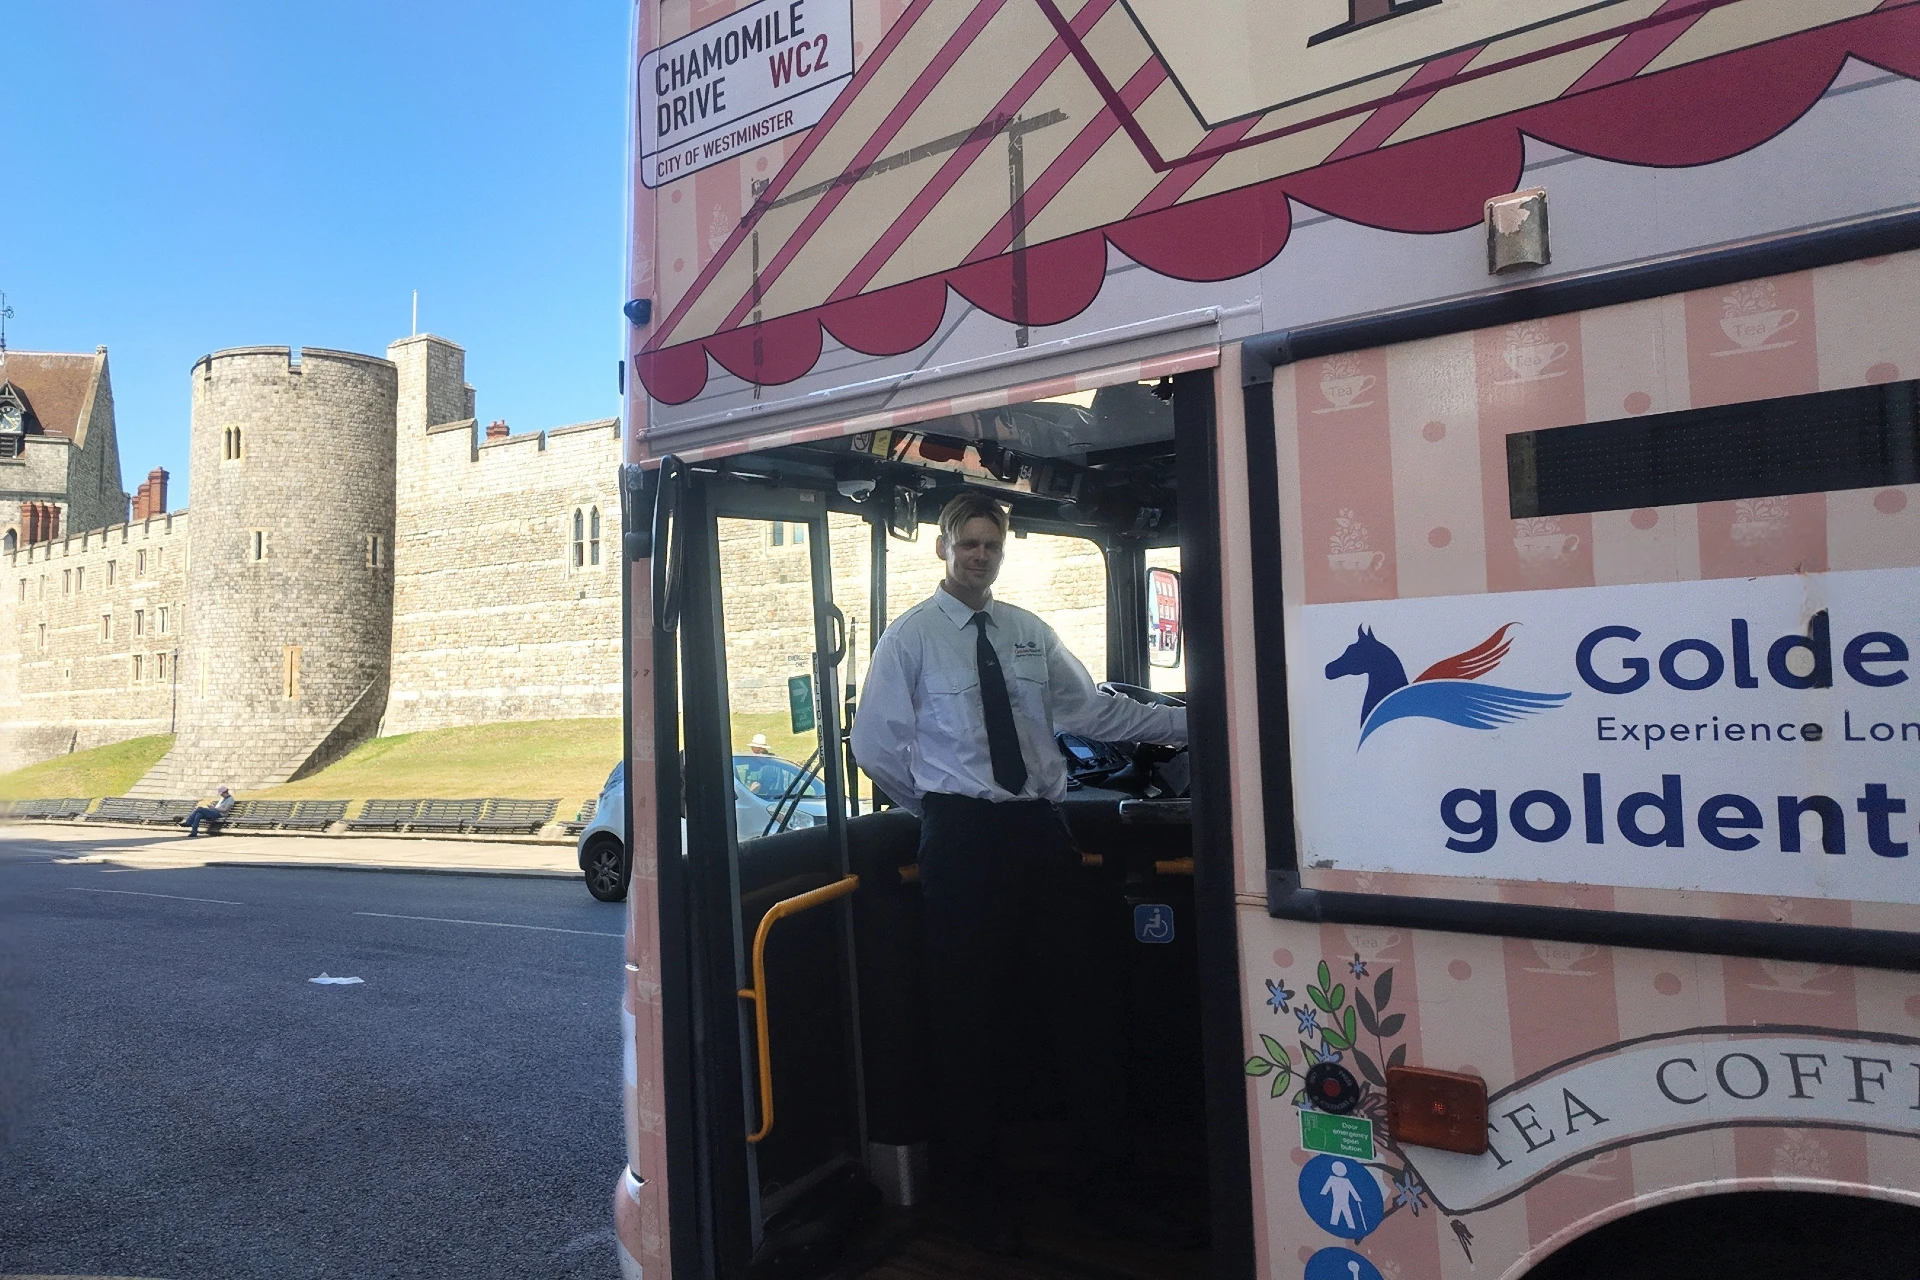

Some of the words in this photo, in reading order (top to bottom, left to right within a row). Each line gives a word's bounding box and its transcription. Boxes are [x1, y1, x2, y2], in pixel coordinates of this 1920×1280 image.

[655, 1, 805, 97] CHAMOMILE
[657, 76, 726, 137] DRIVE
[769, 33, 829, 88] WC2
[658, 153, 681, 177] CITY
[685, 146, 700, 166] OF
[703, 110, 794, 158] WESTMINSTER
[1575, 608, 1909, 695] Golde
[1597, 716, 1824, 750] Experience
[1440, 773, 1920, 858] goldent
[1655, 1052, 1920, 1110] COFF
[1332, 1129, 1369, 1140] emergency
[1340, 1143, 1363, 1153] button
[1341, 1122, 1359, 1130] Door
[1342, 1137, 1360, 1145] open
